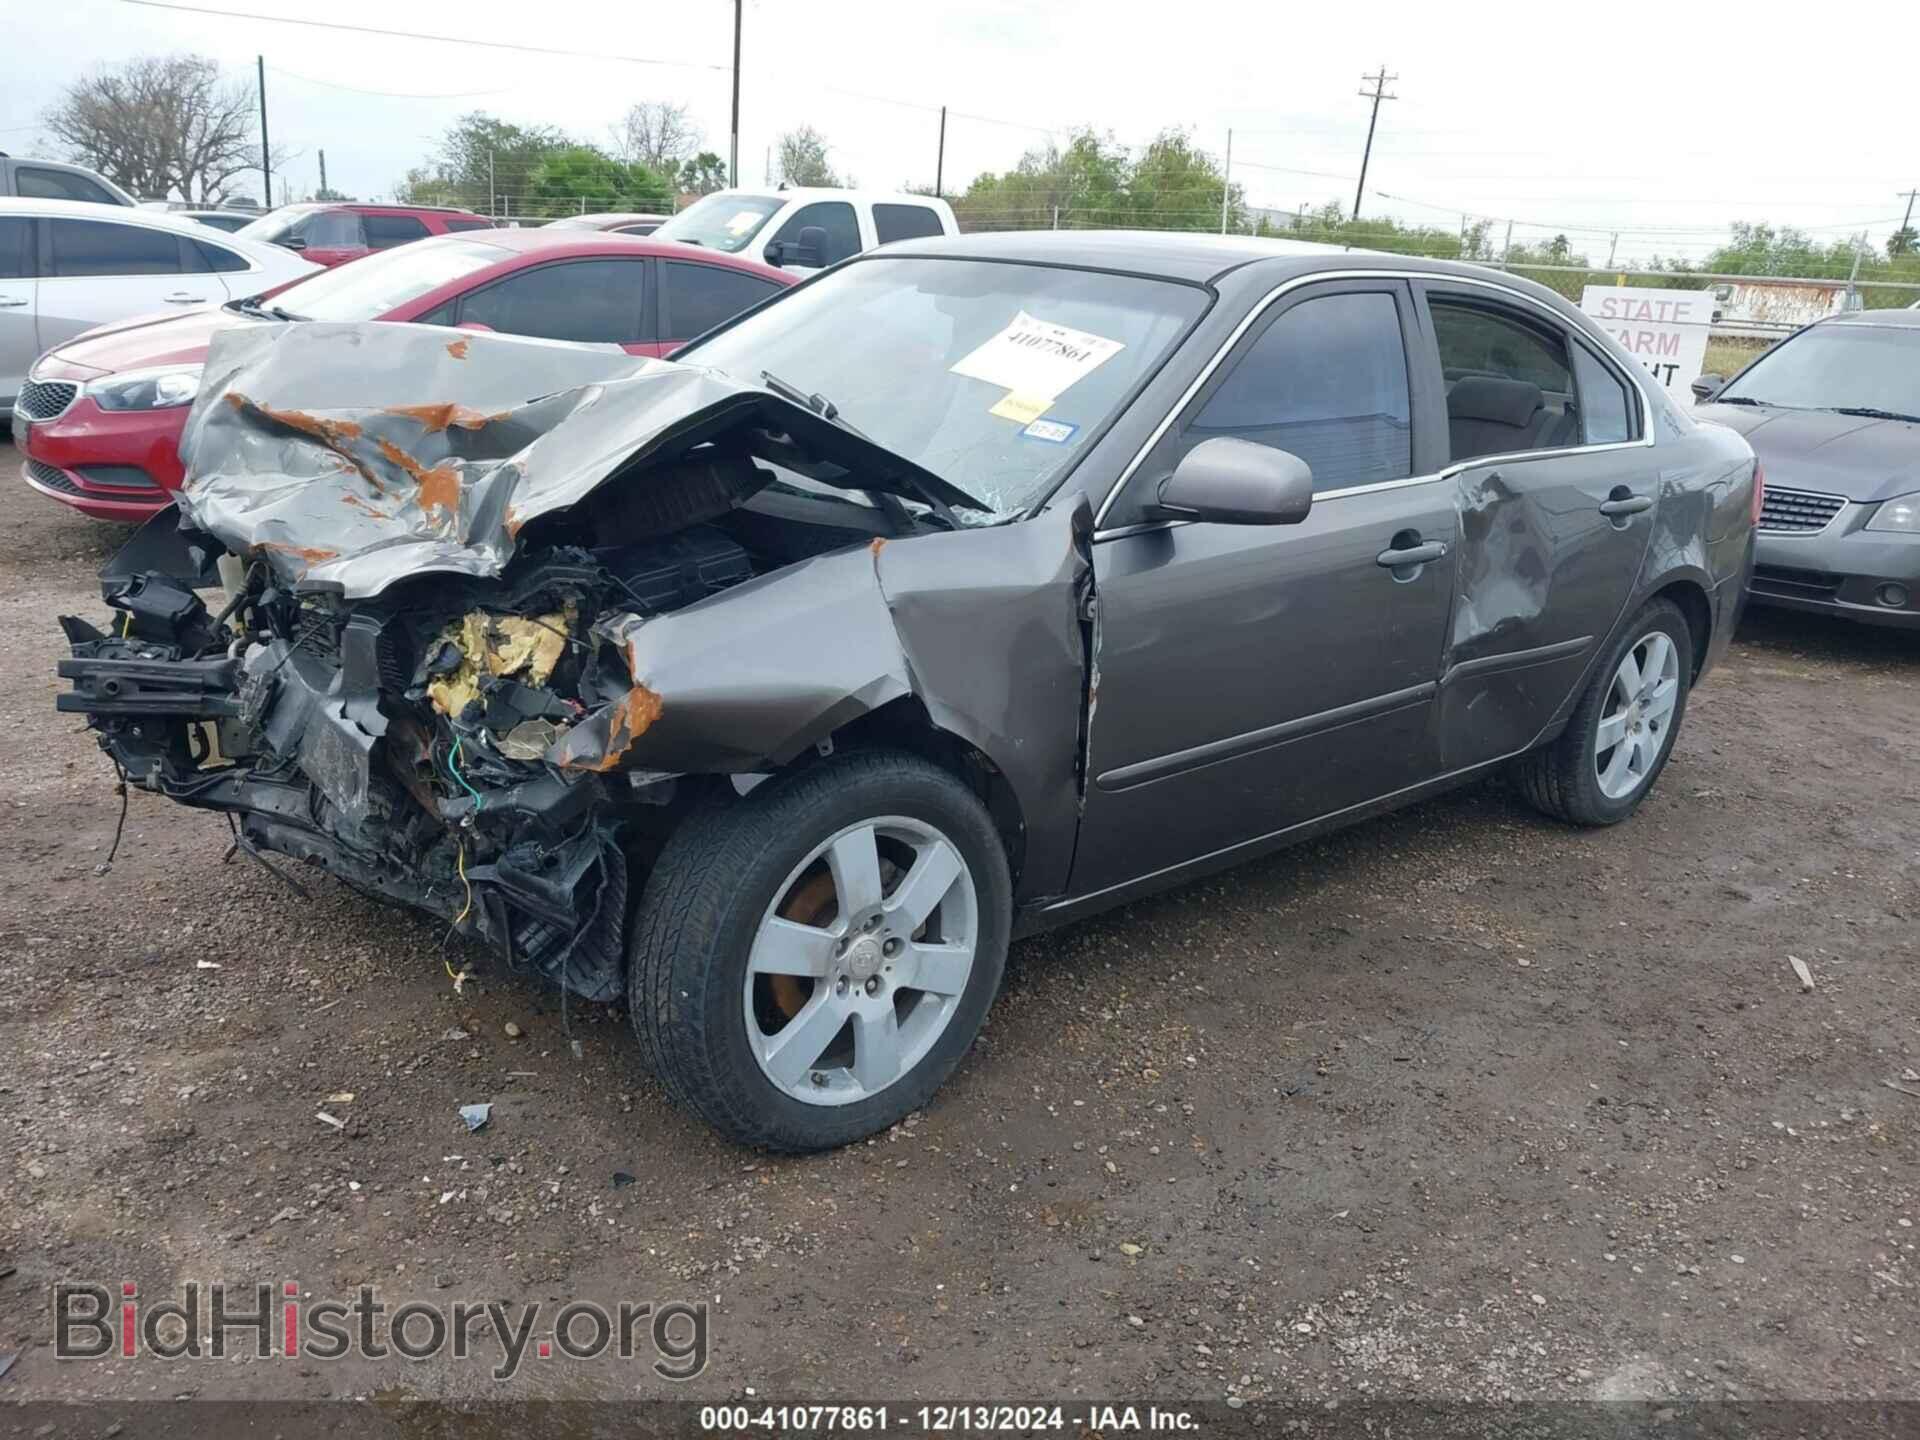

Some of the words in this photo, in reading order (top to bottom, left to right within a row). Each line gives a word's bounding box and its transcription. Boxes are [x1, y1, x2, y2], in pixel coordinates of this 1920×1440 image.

[1600, 297, 1692, 323] STATE
[1008, 331, 1092, 362] 41077861
[1606, 328, 1681, 357] ARM
